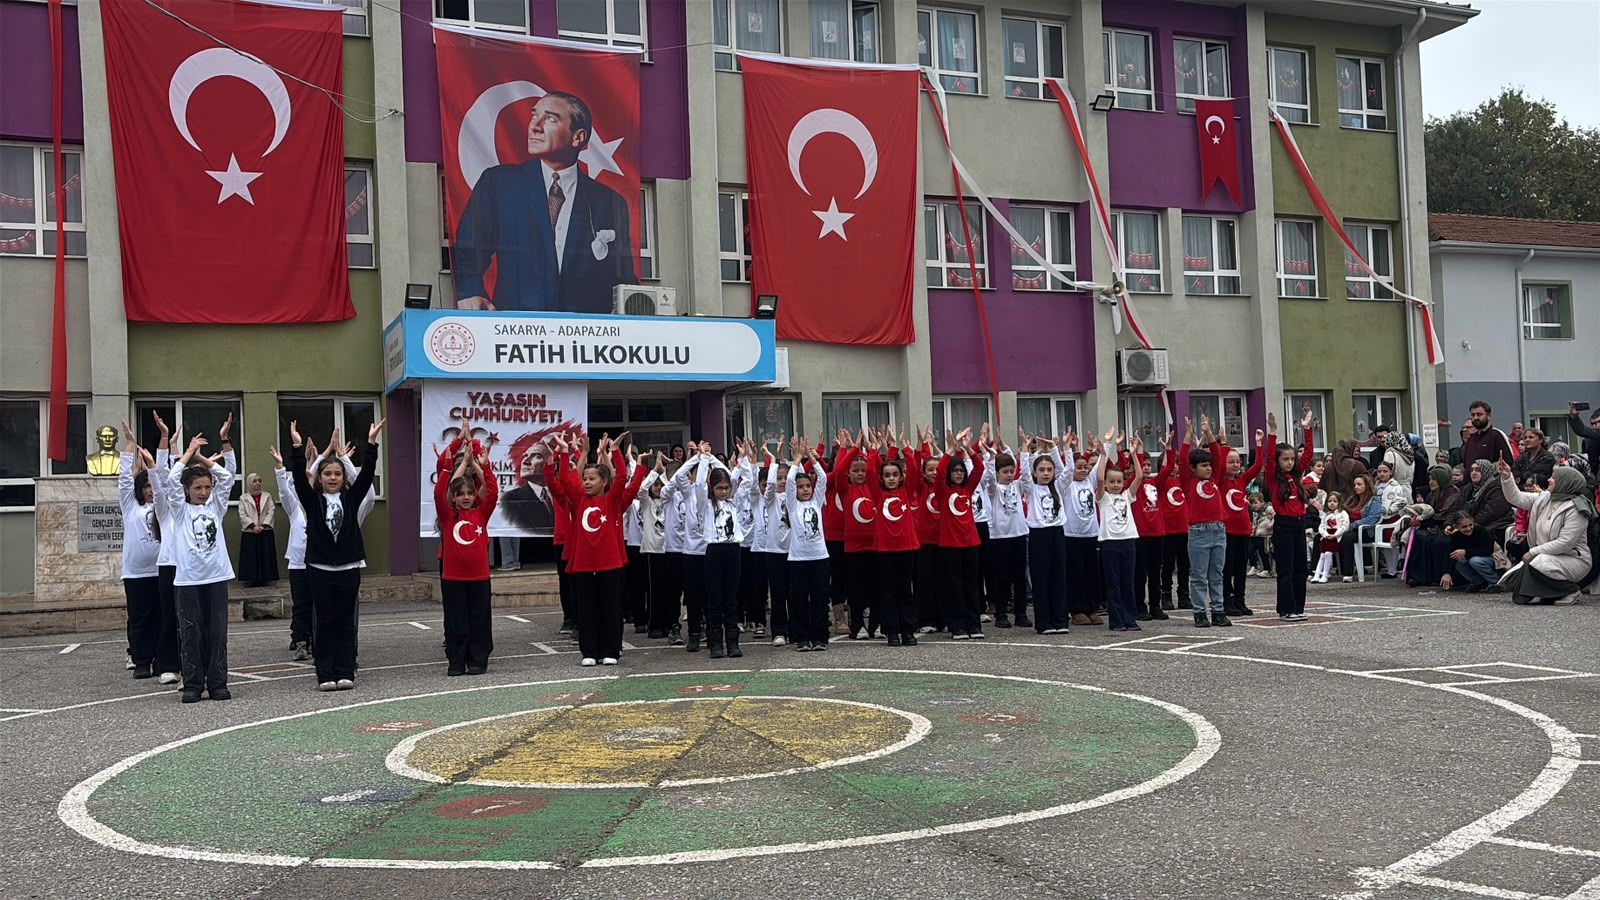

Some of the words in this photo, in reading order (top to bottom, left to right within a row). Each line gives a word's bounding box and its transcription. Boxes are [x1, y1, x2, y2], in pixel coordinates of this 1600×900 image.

[494, 324, 547, 336] SAKARYA
[558, 325, 621, 337] ADAPAZARI
[495, 340, 565, 364] FATİH
[573, 340, 691, 365] İLKOKULU
[467, 391, 547, 408] YAŞASIN
[449, 407, 563, 423] CUMHURİYET!
[82, 505, 104, 515] GELECEK
[112, 532, 124, 541] ESER
